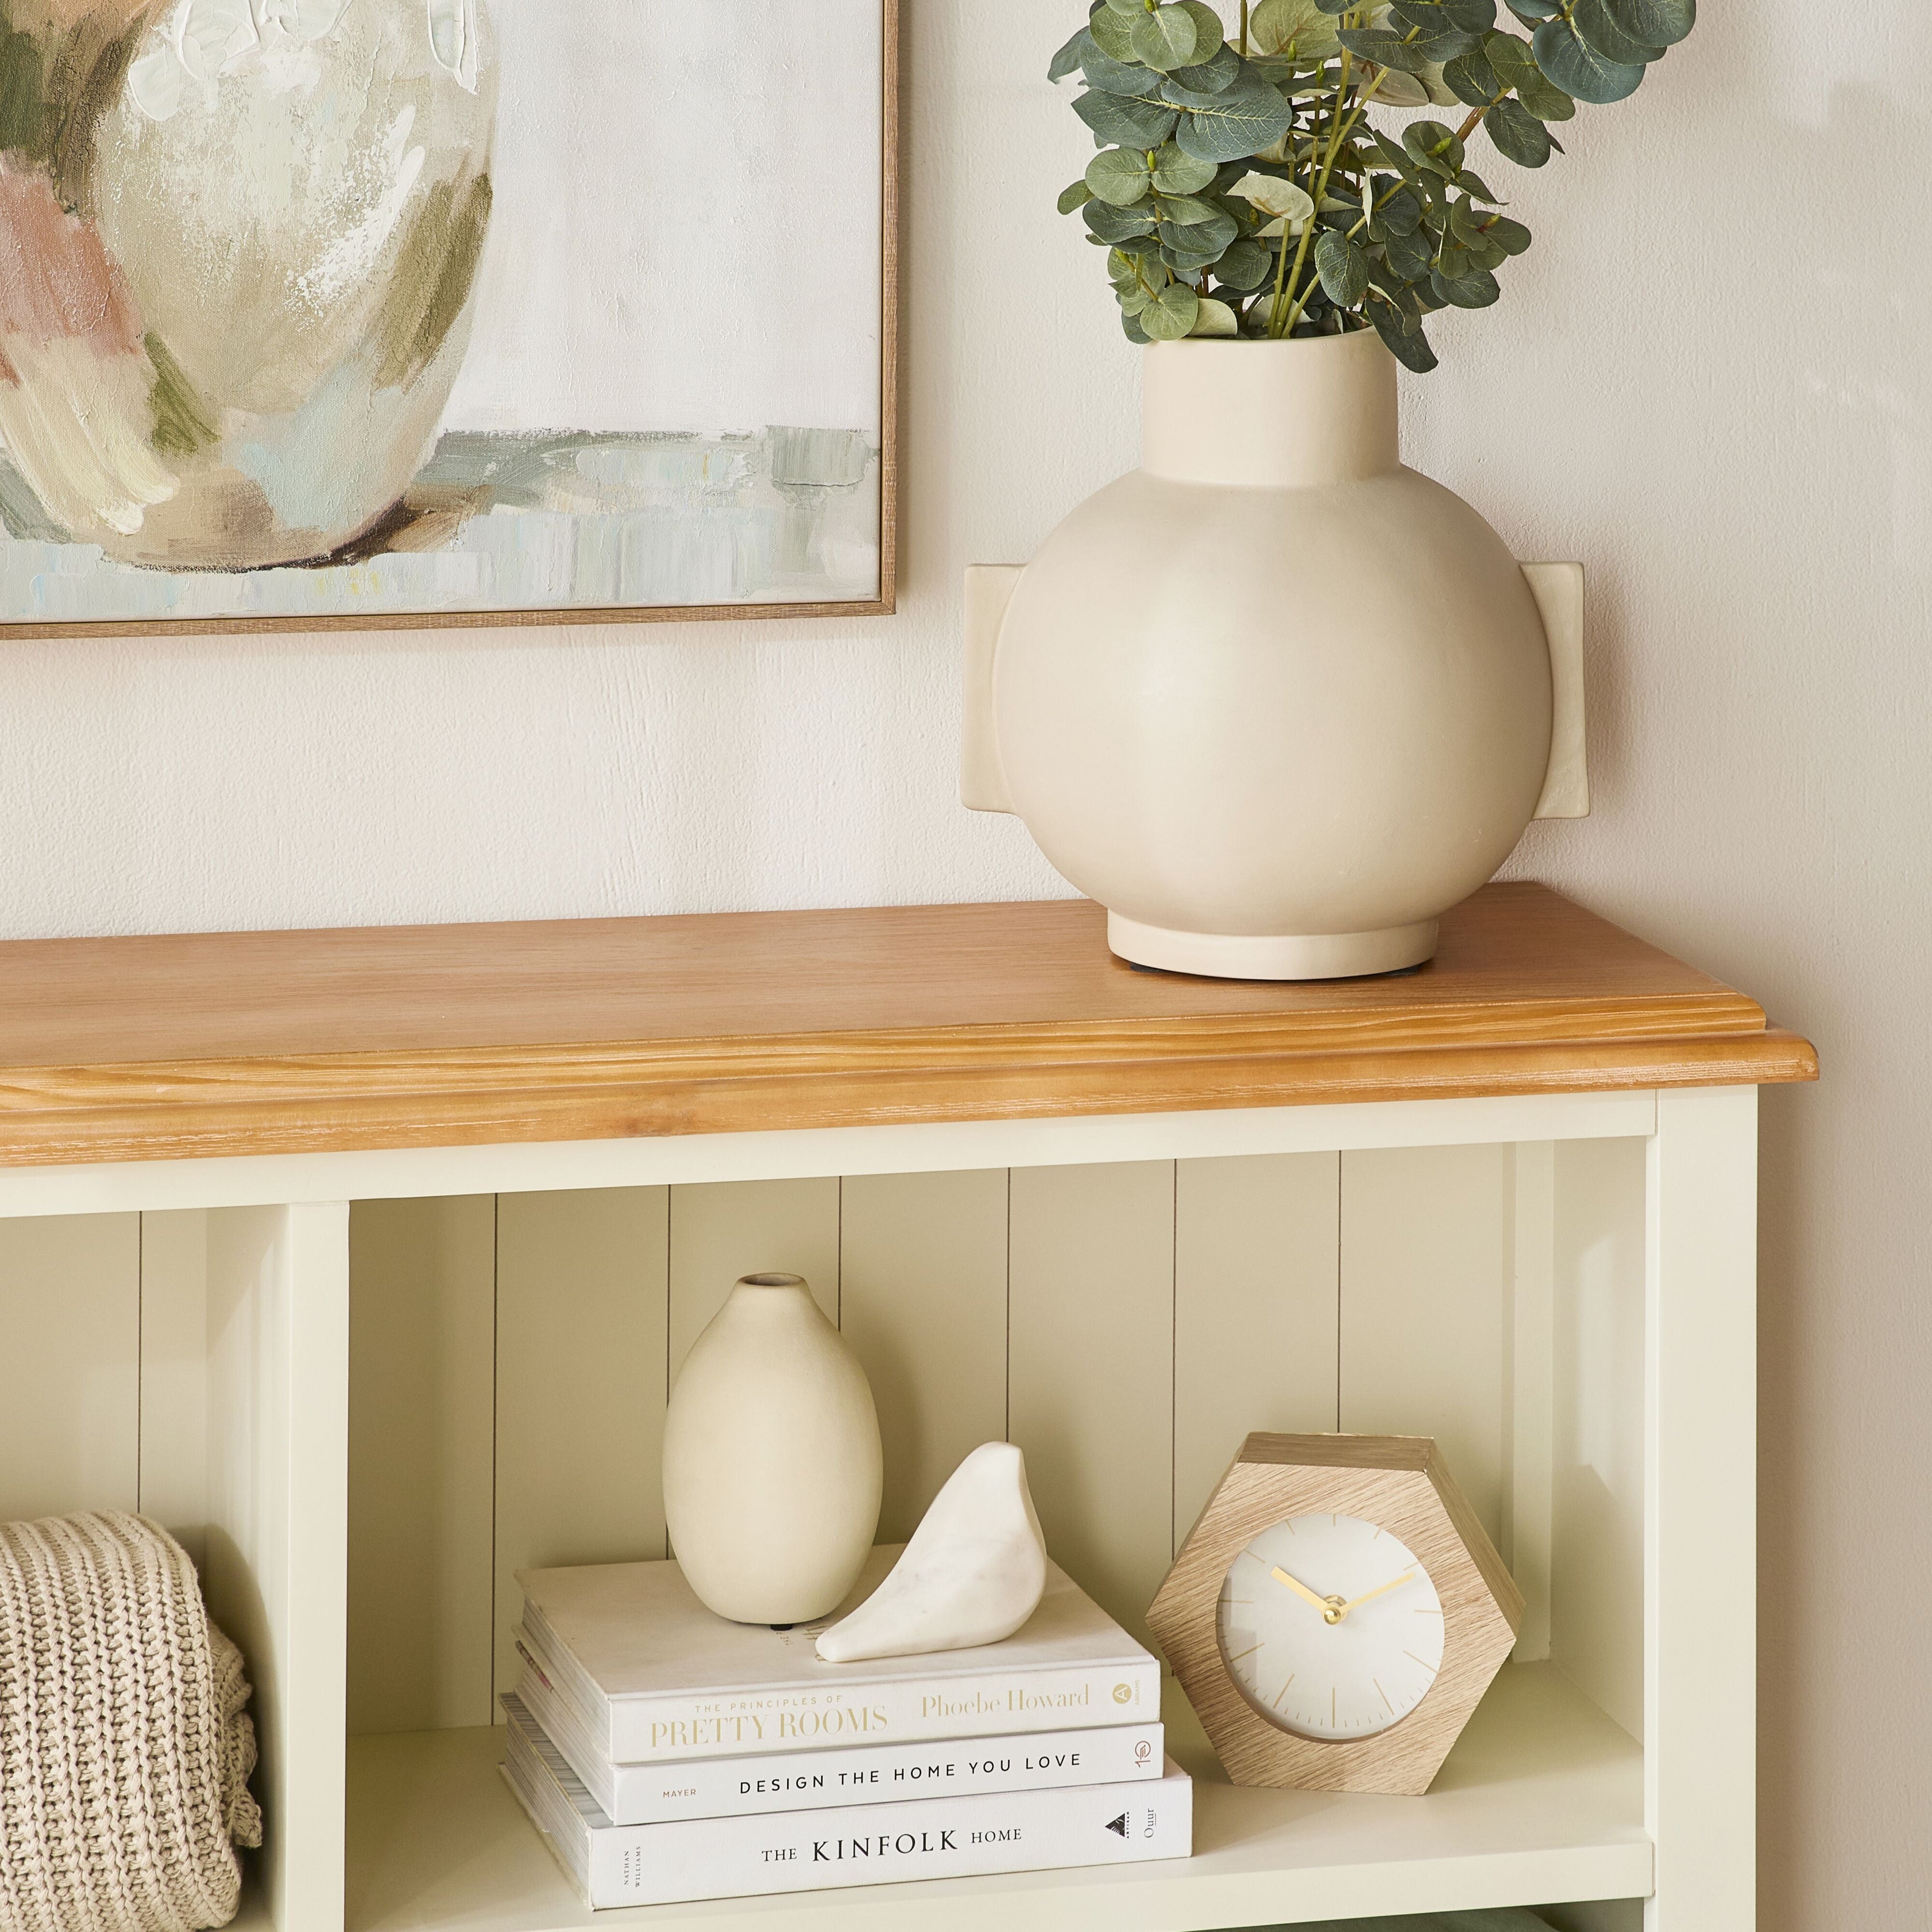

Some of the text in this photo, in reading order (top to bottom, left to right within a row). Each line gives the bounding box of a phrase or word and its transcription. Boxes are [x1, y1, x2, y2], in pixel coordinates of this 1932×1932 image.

[651, 1684, 1089, 1748] PRETTY ROOMS Phoebe Howard
[695, 1695, 842, 1713] THE PRINCIPLES OF
[663, 1753, 1080, 1798] MAYER DESIGN THE HOME YOU LOVE
[1144, 1808, 1154, 1838] Ouur
[761, 1828, 1022, 1862] THE KINFOLK HOME
